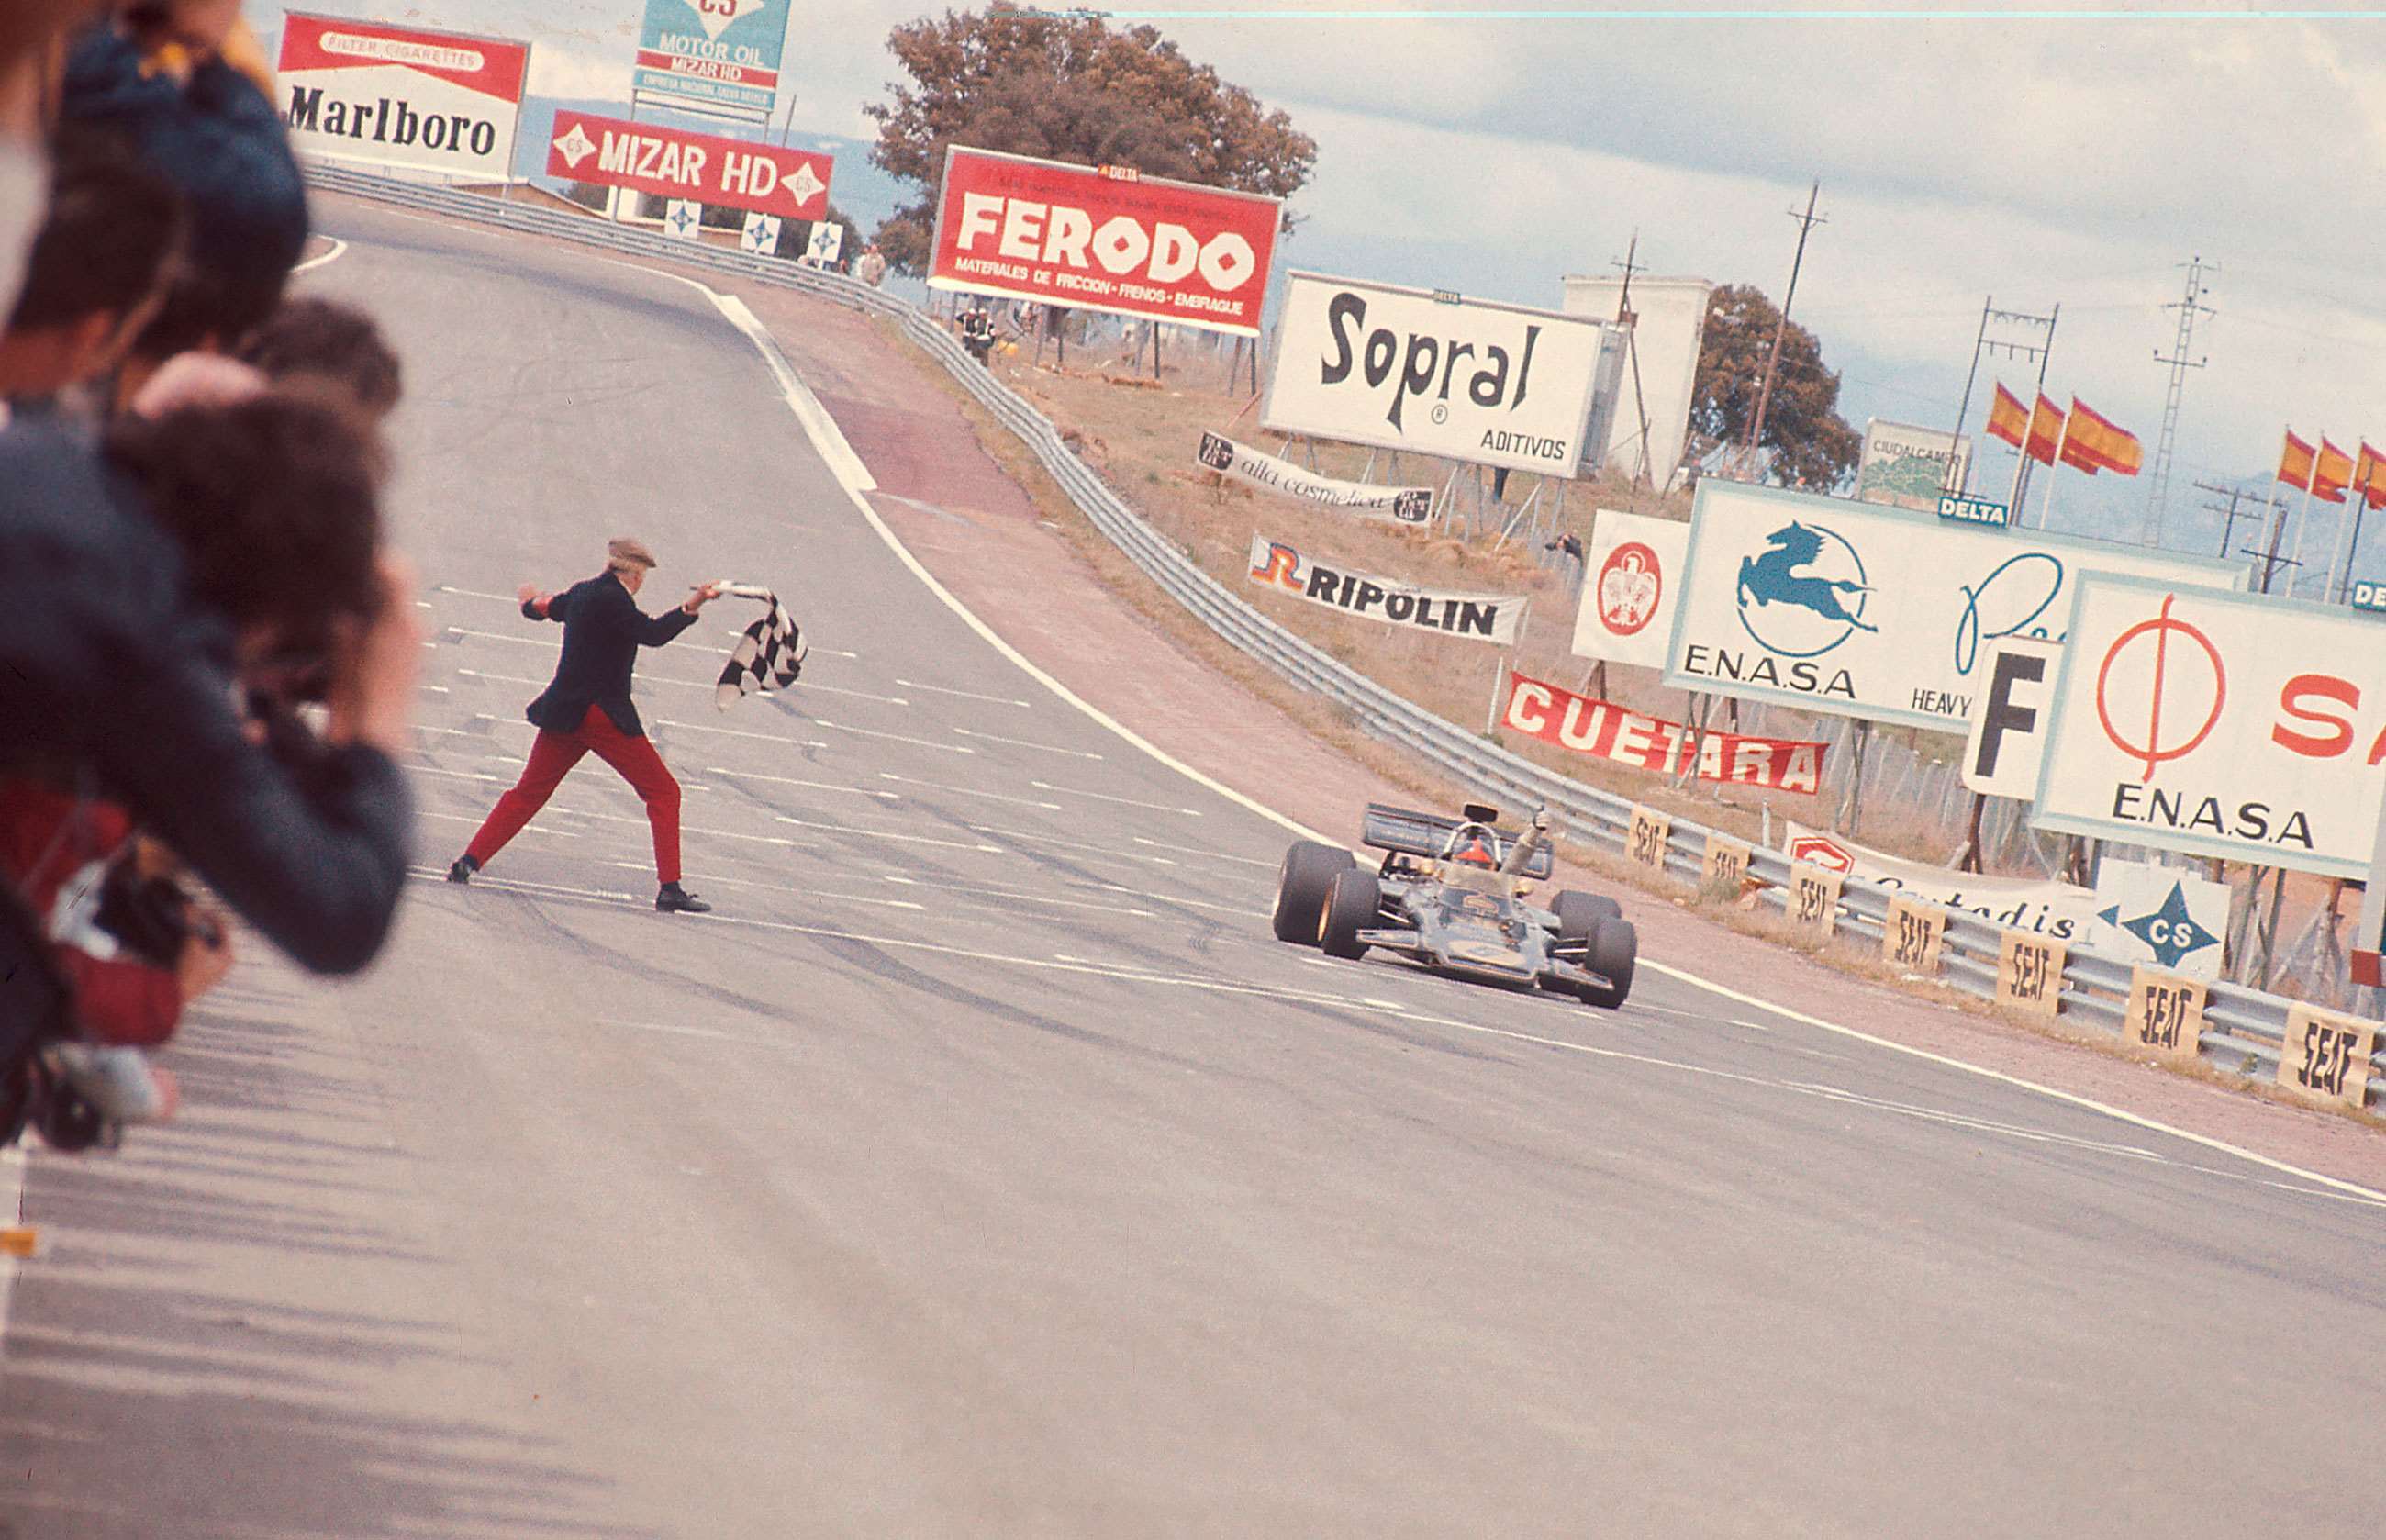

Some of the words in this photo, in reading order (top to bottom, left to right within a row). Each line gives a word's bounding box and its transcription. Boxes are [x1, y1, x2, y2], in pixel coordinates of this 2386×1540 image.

[327, 35, 377, 52] FILTER
[384, 41, 477, 67] CIGARETTES
[659, 32, 730, 61] MOTOR
[735, 45, 764, 67] OIL
[671, 57, 719, 77] MIZAR
[719, 65, 742, 81] HD
[288, 85, 496, 156] Marlboro
[598, 130, 708, 187] MIZAR
[720, 151, 777, 196] HD
[1109, 165, 1138, 182] DELTA
[956, 192, 1255, 292] FERODO
[955, 257, 1028, 281] MATERIALES
[1033, 269, 1051, 284] DE
[1056, 273, 1110, 295] FRICCION
[1118, 284, 1165, 305] FRENOS
[1175, 295, 1244, 316] EMBRAGUE
[1321, 292, 1542, 436] Sopral
[1481, 430, 1566, 460] ADITIVOS
[1940, 498, 2004, 524] DELTA
[1306, 565, 1498, 636] RIPOLIN
[1684, 644, 1856, 699] E.N.A.S.A
[1912, 688, 1972, 717] HEAVY
[1508, 682, 1817, 794] CUETARA
[2113, 782, 2314, 850] E.N.A.S.A
[2148, 919, 2194, 949] CS
[2009, 943, 2050, 1001] SEAT
[2140, 985, 2193, 1050] SEAT
[2297, 1021, 2358, 1096] SEAT
